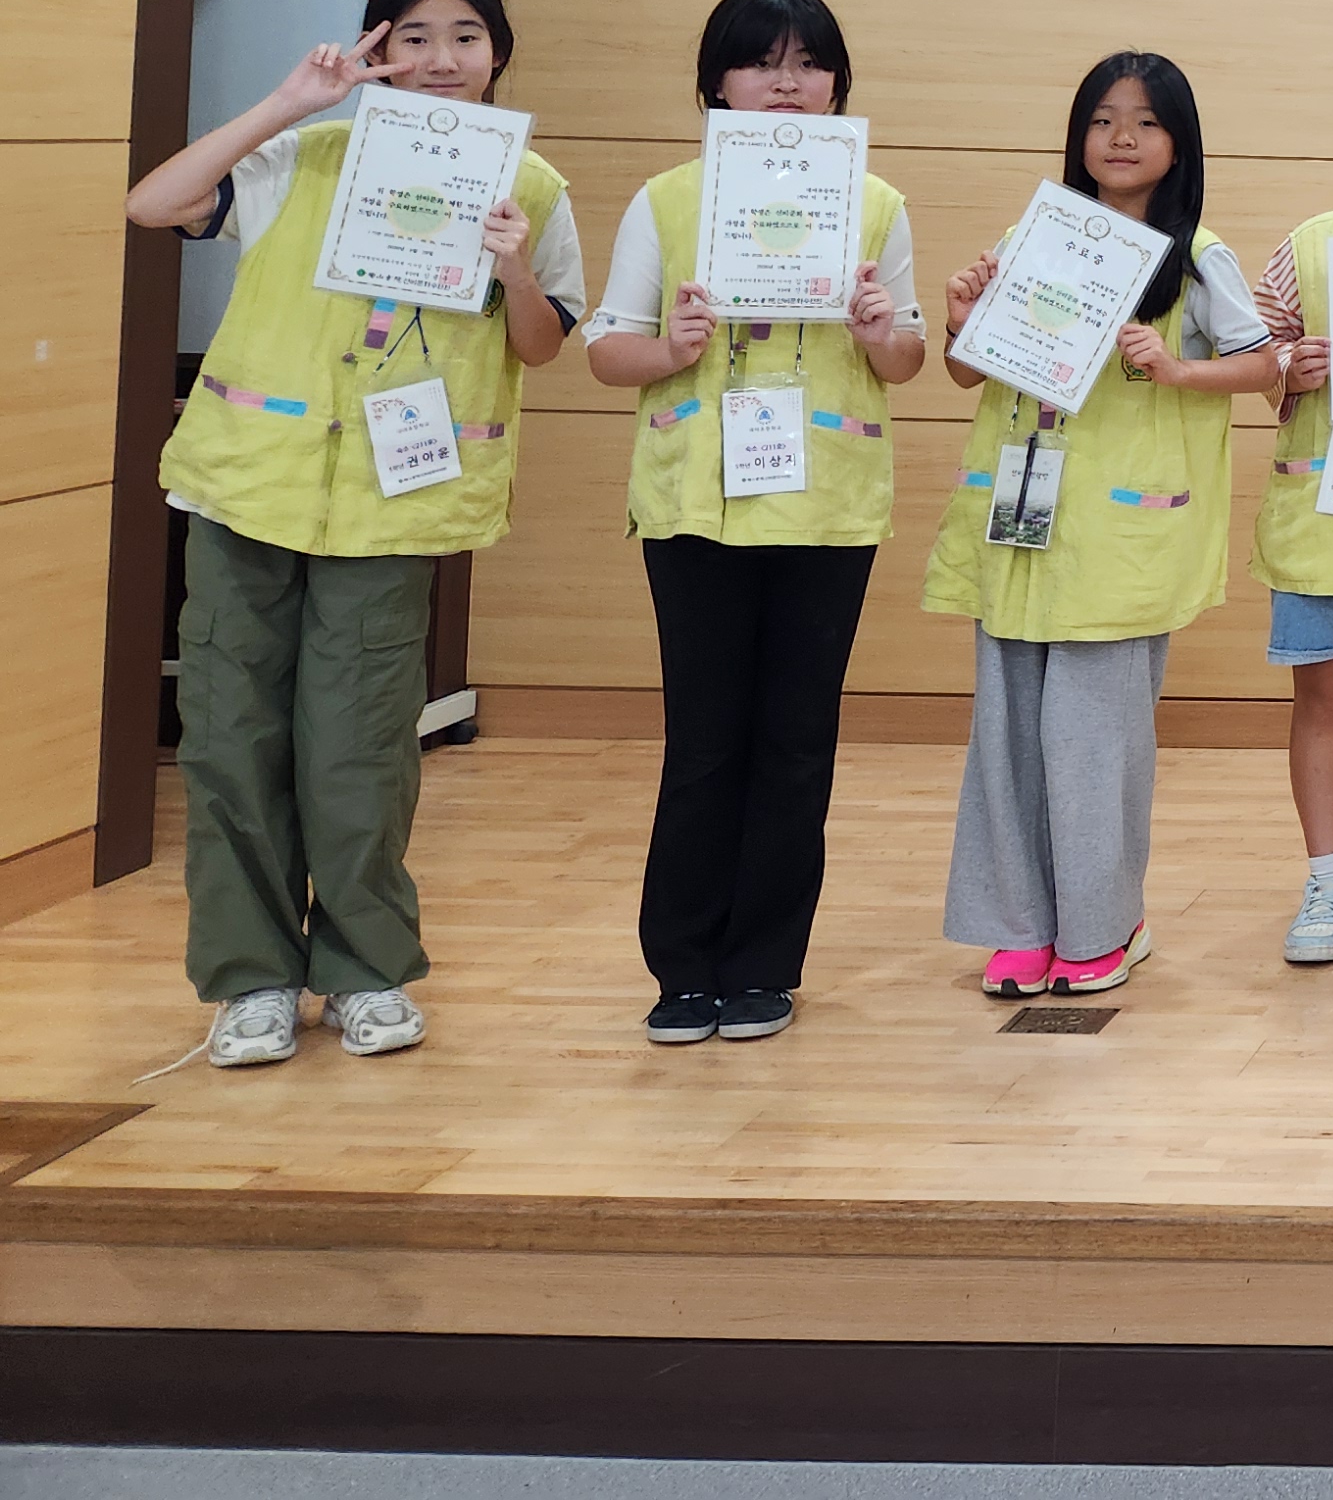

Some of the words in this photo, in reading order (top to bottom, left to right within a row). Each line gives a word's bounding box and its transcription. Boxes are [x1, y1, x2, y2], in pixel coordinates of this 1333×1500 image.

[410, 140, 460, 159] 수료증
[762, 158, 809, 171] 수료증
[1065, 240, 1103, 265] 수료증
[406, 447, 449, 468] 권아윤
[754, 453, 796, 469] 이상지
